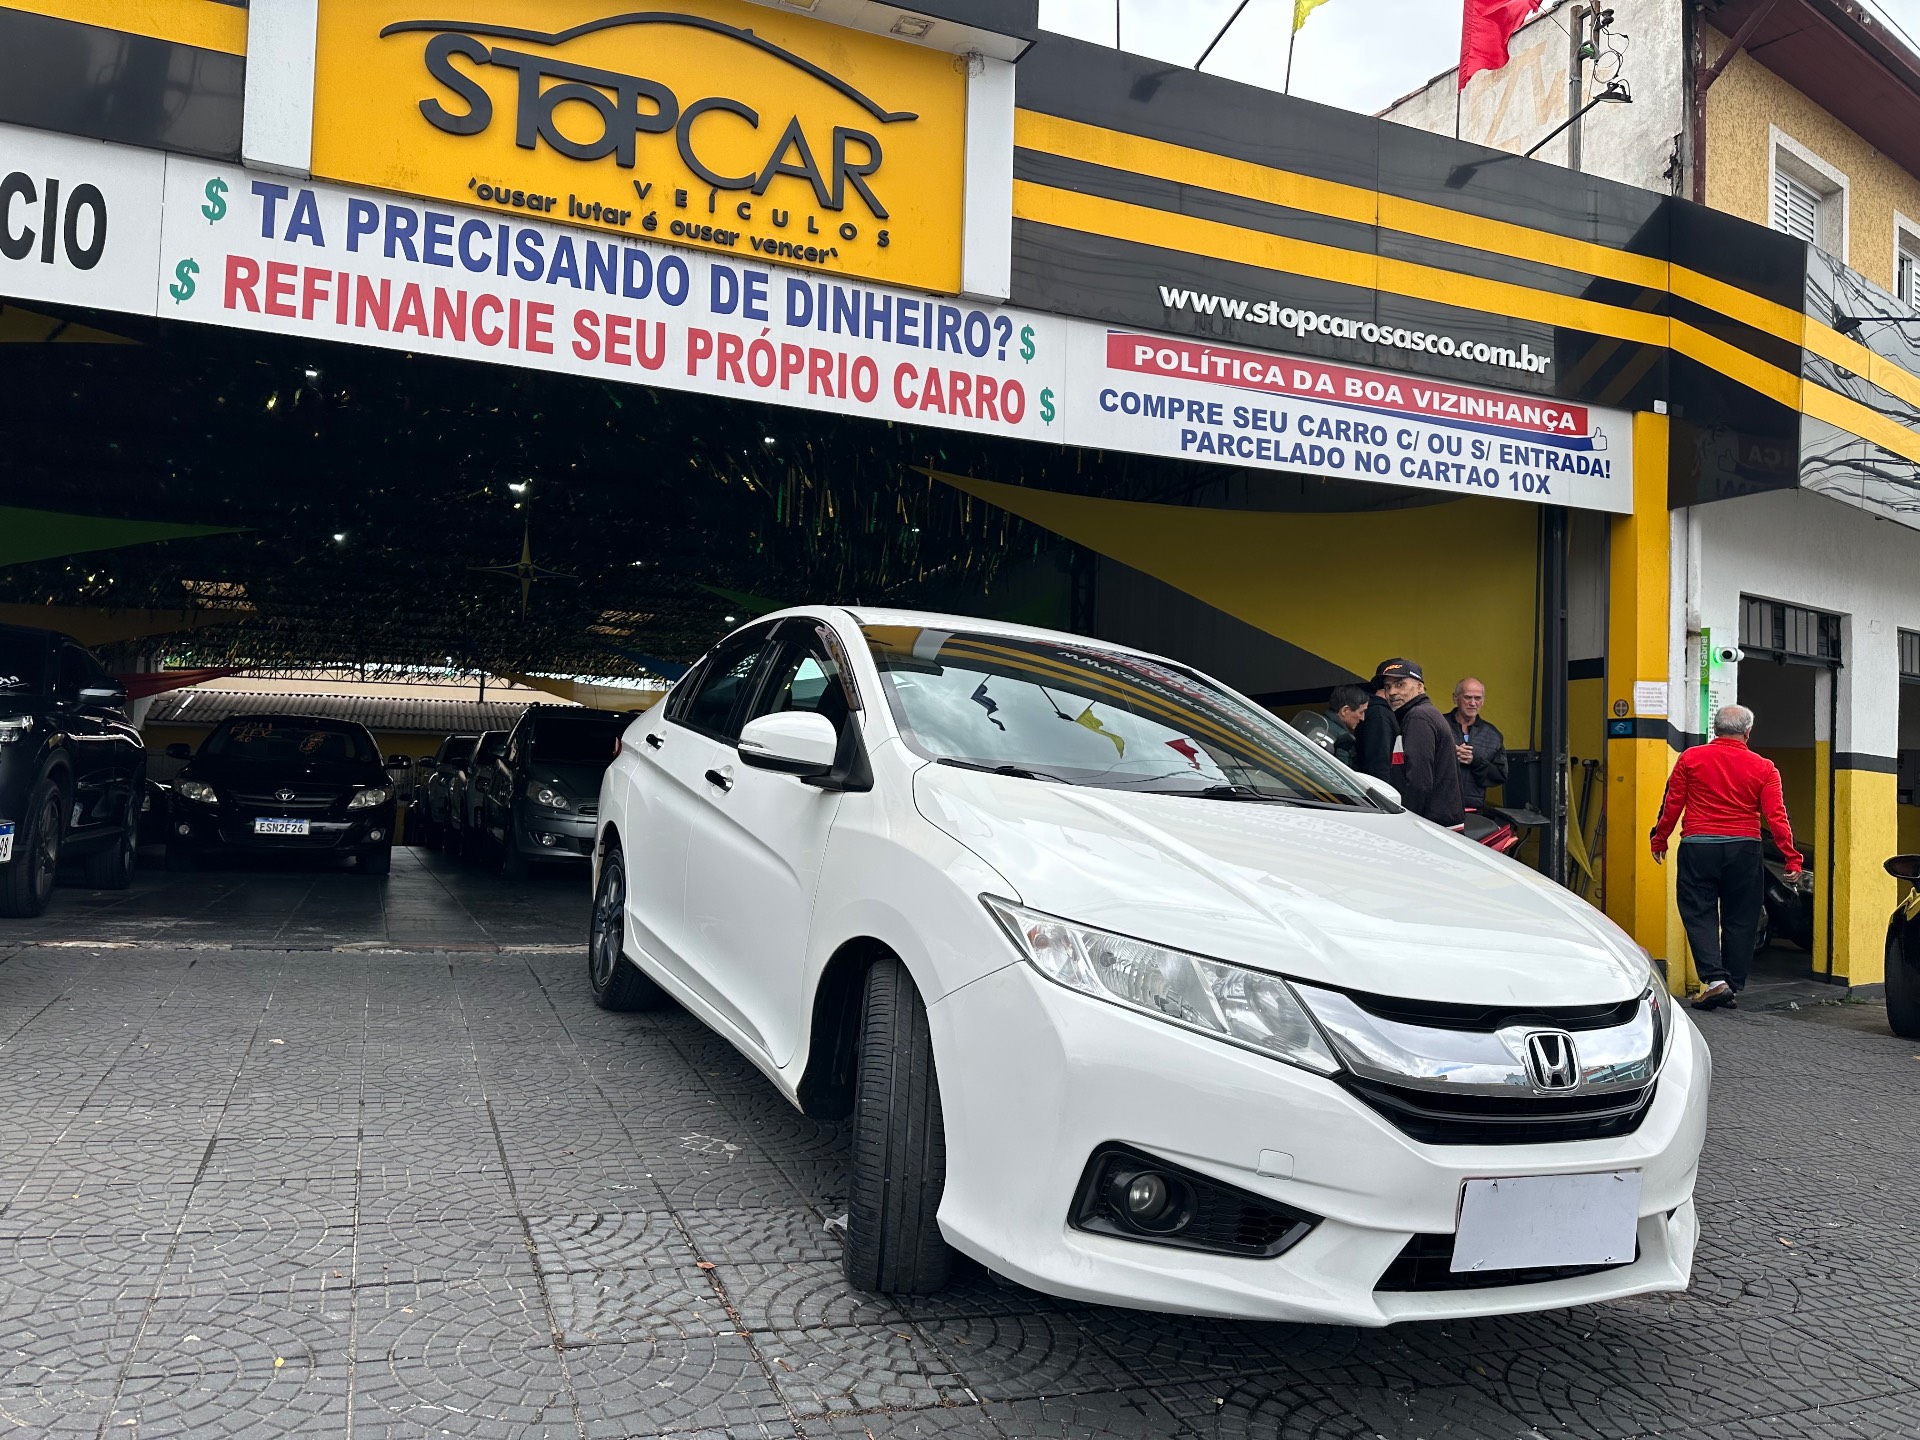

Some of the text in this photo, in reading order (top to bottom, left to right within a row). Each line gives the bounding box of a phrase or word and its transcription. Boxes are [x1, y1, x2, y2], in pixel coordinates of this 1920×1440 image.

[419, 33, 890, 220] STOPCAR
[568, 194, 632, 227] lutar
[643, 211, 658, 231] é
[671, 220, 740, 247] ousar
[633, 180, 890, 248] VEÍCULOS
[251, 180, 325, 247] TA
[346, 198, 690, 307] PRECISANDO
[710, 263, 770, 322] DE
[786, 277, 1013, 362] DINHEIRO?
[224, 254, 554, 354] REFINANCIE
[572, 309, 666, 371] SEU
[687, 327, 879, 402] PRÓPRIO
[893, 362, 1025, 424] CARRO
[1158, 285, 1551, 374] www.stopcarosasco.com.br
[1134, 345, 1576, 432] POLÍTICA DA BOA VIZINHANÇA
[1099, 388, 1611, 479] COMPRE SEU CARRO C/ OU S/ ENTRADA!
[1181, 428, 1551, 495] PARCELADO NO CARTAO 10X
[1700, 635, 1708, 667] Gabriel
[259, 822, 304, 833] ESN2F26
